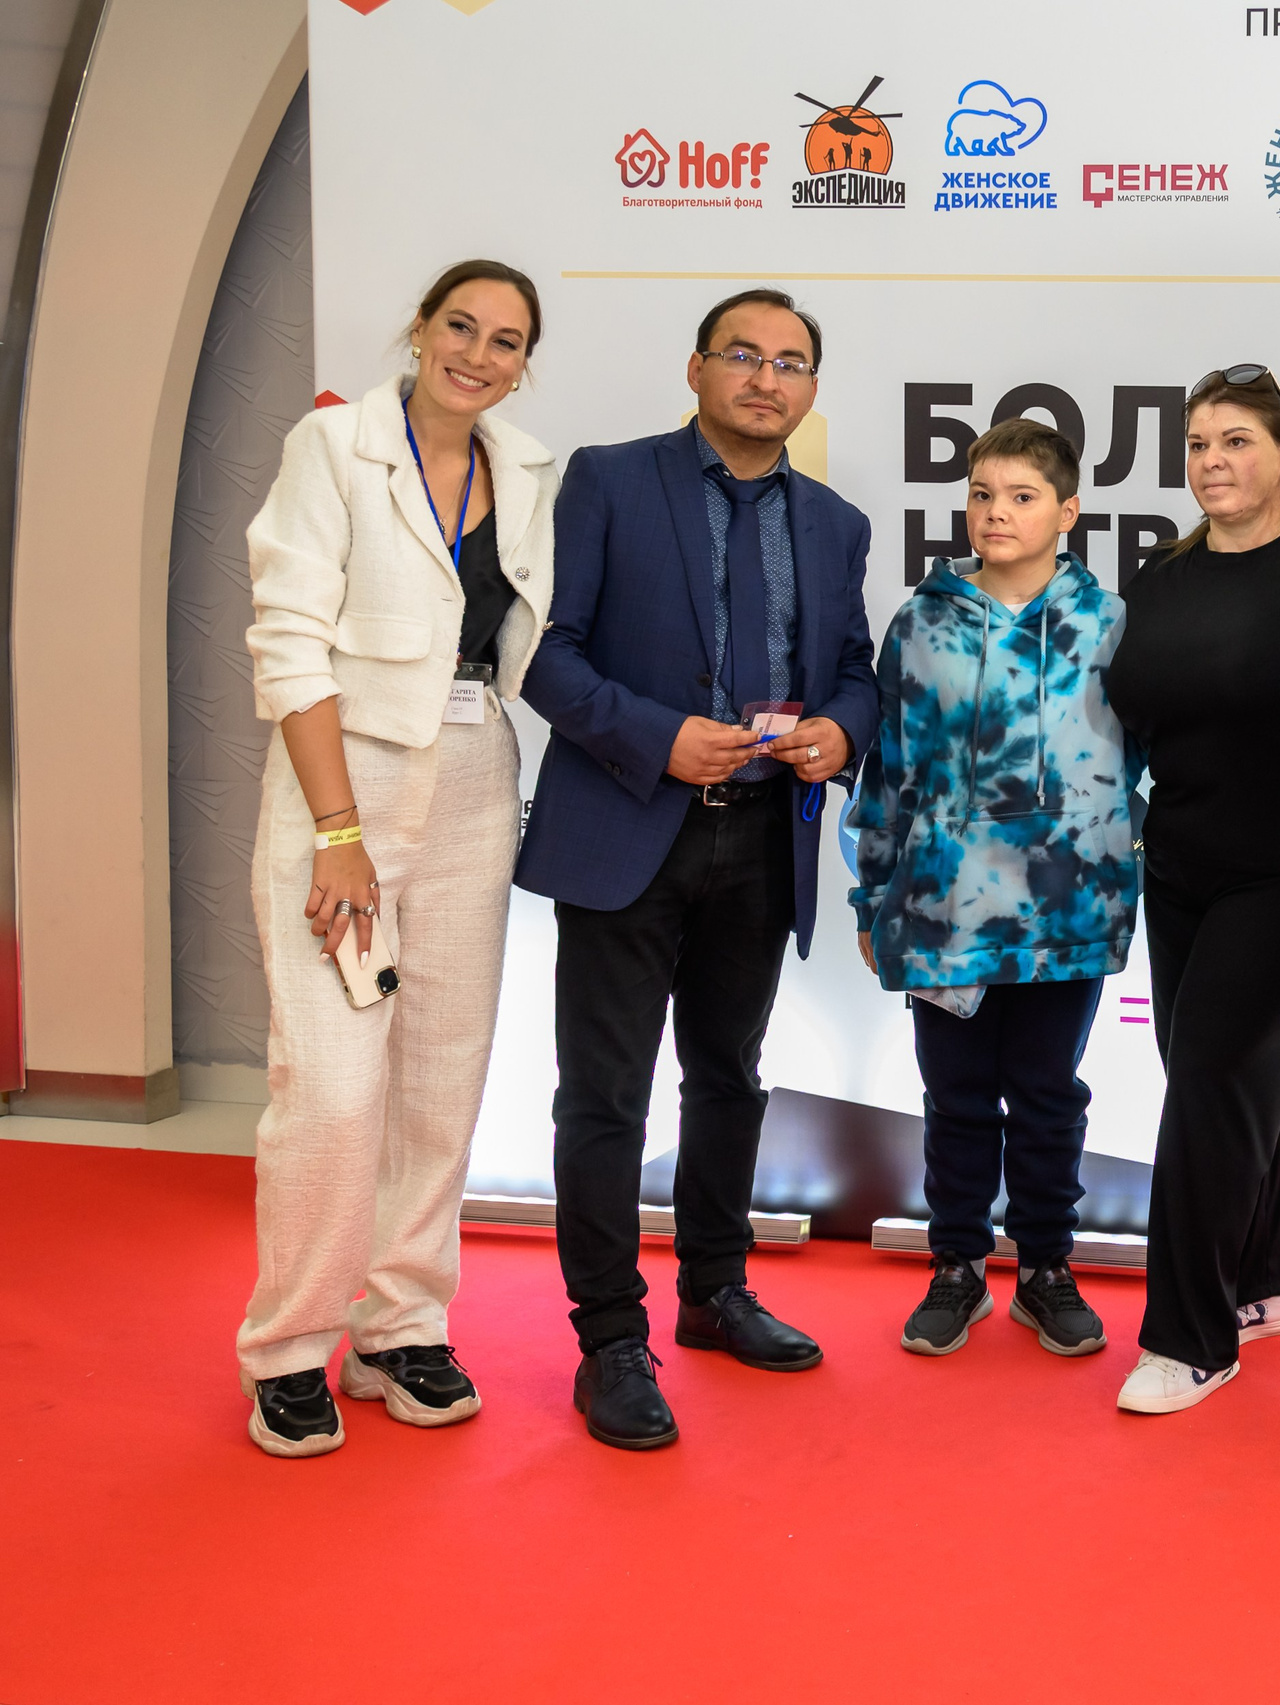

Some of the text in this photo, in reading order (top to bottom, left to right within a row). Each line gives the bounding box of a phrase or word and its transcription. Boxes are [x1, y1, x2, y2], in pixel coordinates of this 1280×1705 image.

[941, 172, 1051, 189] ЖЕНСКОЕ
[792, 174, 906, 206] ЭКСПЕДИЦИЯ
[1117, 194, 1230, 203] МАСТЕРСКАЯ УПРАВЛЕНИЯ
[622, 196, 764, 212] Благотворительный фонд
[934, 191, 1058, 211] ДВИЖЕНИЕ
